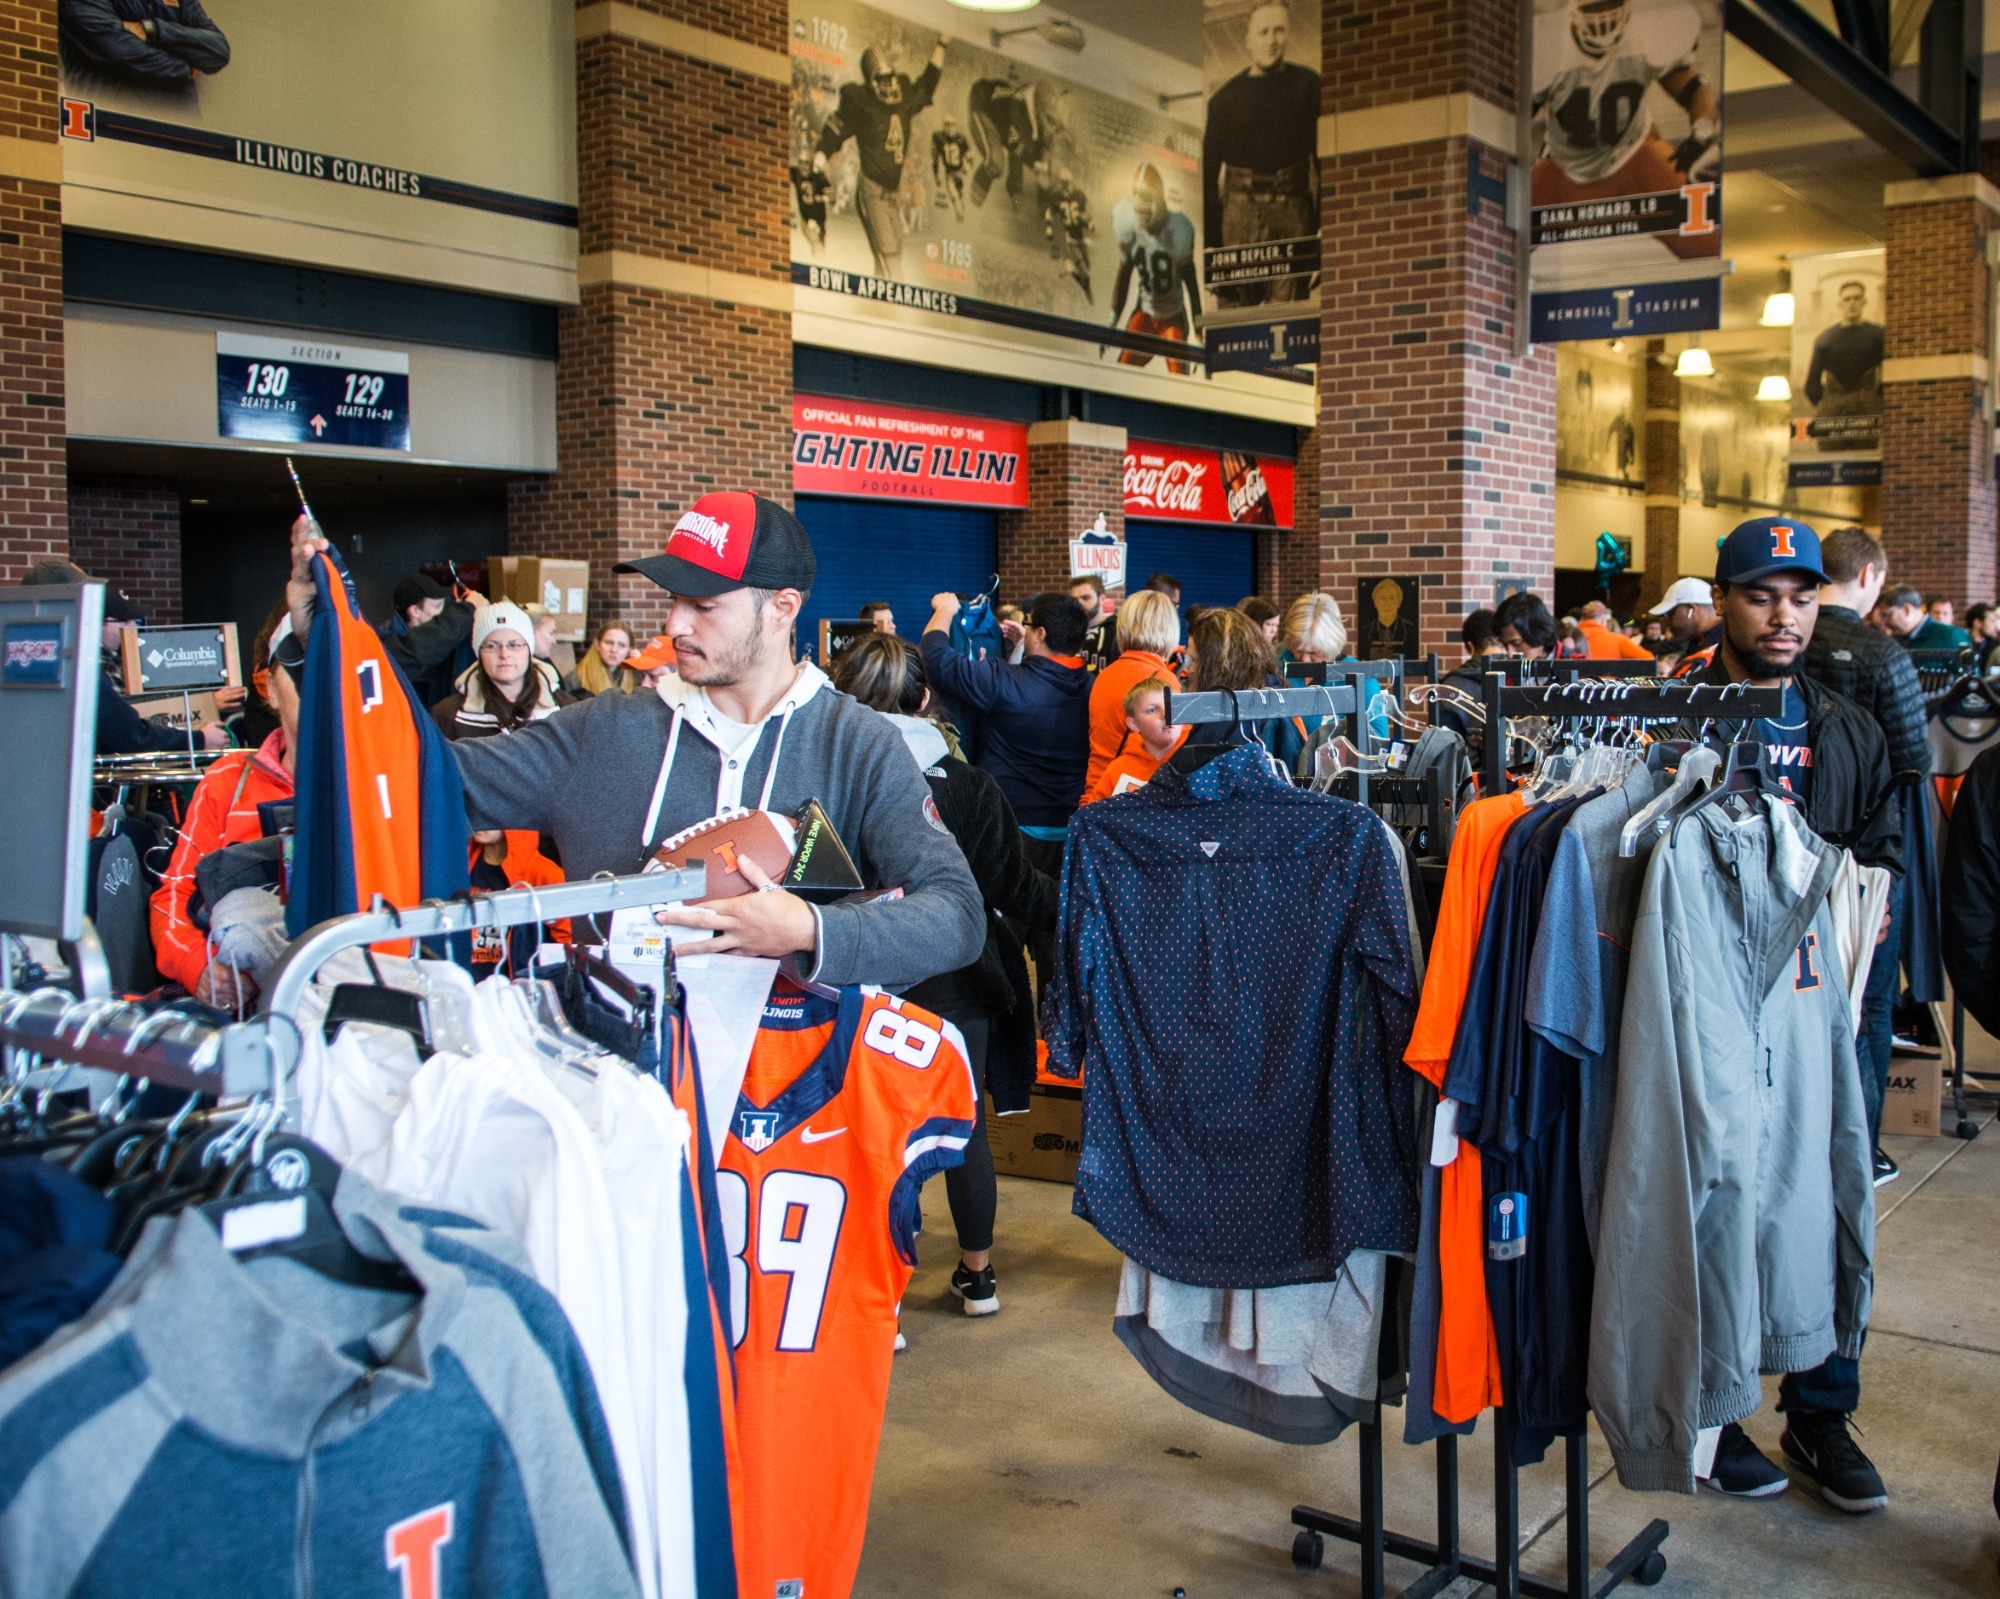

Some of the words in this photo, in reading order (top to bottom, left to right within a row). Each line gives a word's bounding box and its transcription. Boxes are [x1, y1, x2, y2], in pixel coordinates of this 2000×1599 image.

[811, 16, 848, 50] 1982
[1555, 80, 1645, 148] 40
[235, 138, 324, 176] ILLINOIS
[333, 159, 421, 196] COACHES
[1540, 208, 1574, 226] DANA
[1540, 223, 1612, 243] ALL-AMERICAN
[941, 238, 973, 268] 1985
[1210, 251, 1238, 267] JOHN
[809, 265, 853, 294] BOWL
[857, 276, 958, 315] APPEARANCES
[1547, 304, 1611, 321] MEMORIAL
[1635, 297, 1700, 314] STADIUM
[290, 345, 342, 361] SECTION
[1218, 338, 1270, 353] MEMORIAL
[246, 362, 290, 397] 130
[345, 373, 385, 405] 129
[240, 396, 270, 410] SEATS
[336, 405, 363, 418] SEATS
[802, 408, 854, 427] OFFICIAL
[855, 414, 877, 429] FAN
[877, 418, 949, 437] REFRESHMENT
[951, 426, 964, 439] OF
[966, 428, 985, 442] THE
[929, 445, 1019, 485] ILLINI
[1140, 454, 1164, 466] DRINK
[861, 480, 935, 496] FOOTBALL
[1077, 547, 1121, 570] ILLINOIS
[163, 646, 217, 661] Columbia
[808, 819, 822, 838] NIKE
[798, 837, 816, 863] VAPOR
[792, 862, 806, 882] 24/7
[762, 1005, 805, 1019] LINOIS
[777, 1584, 792, 1597] 42
